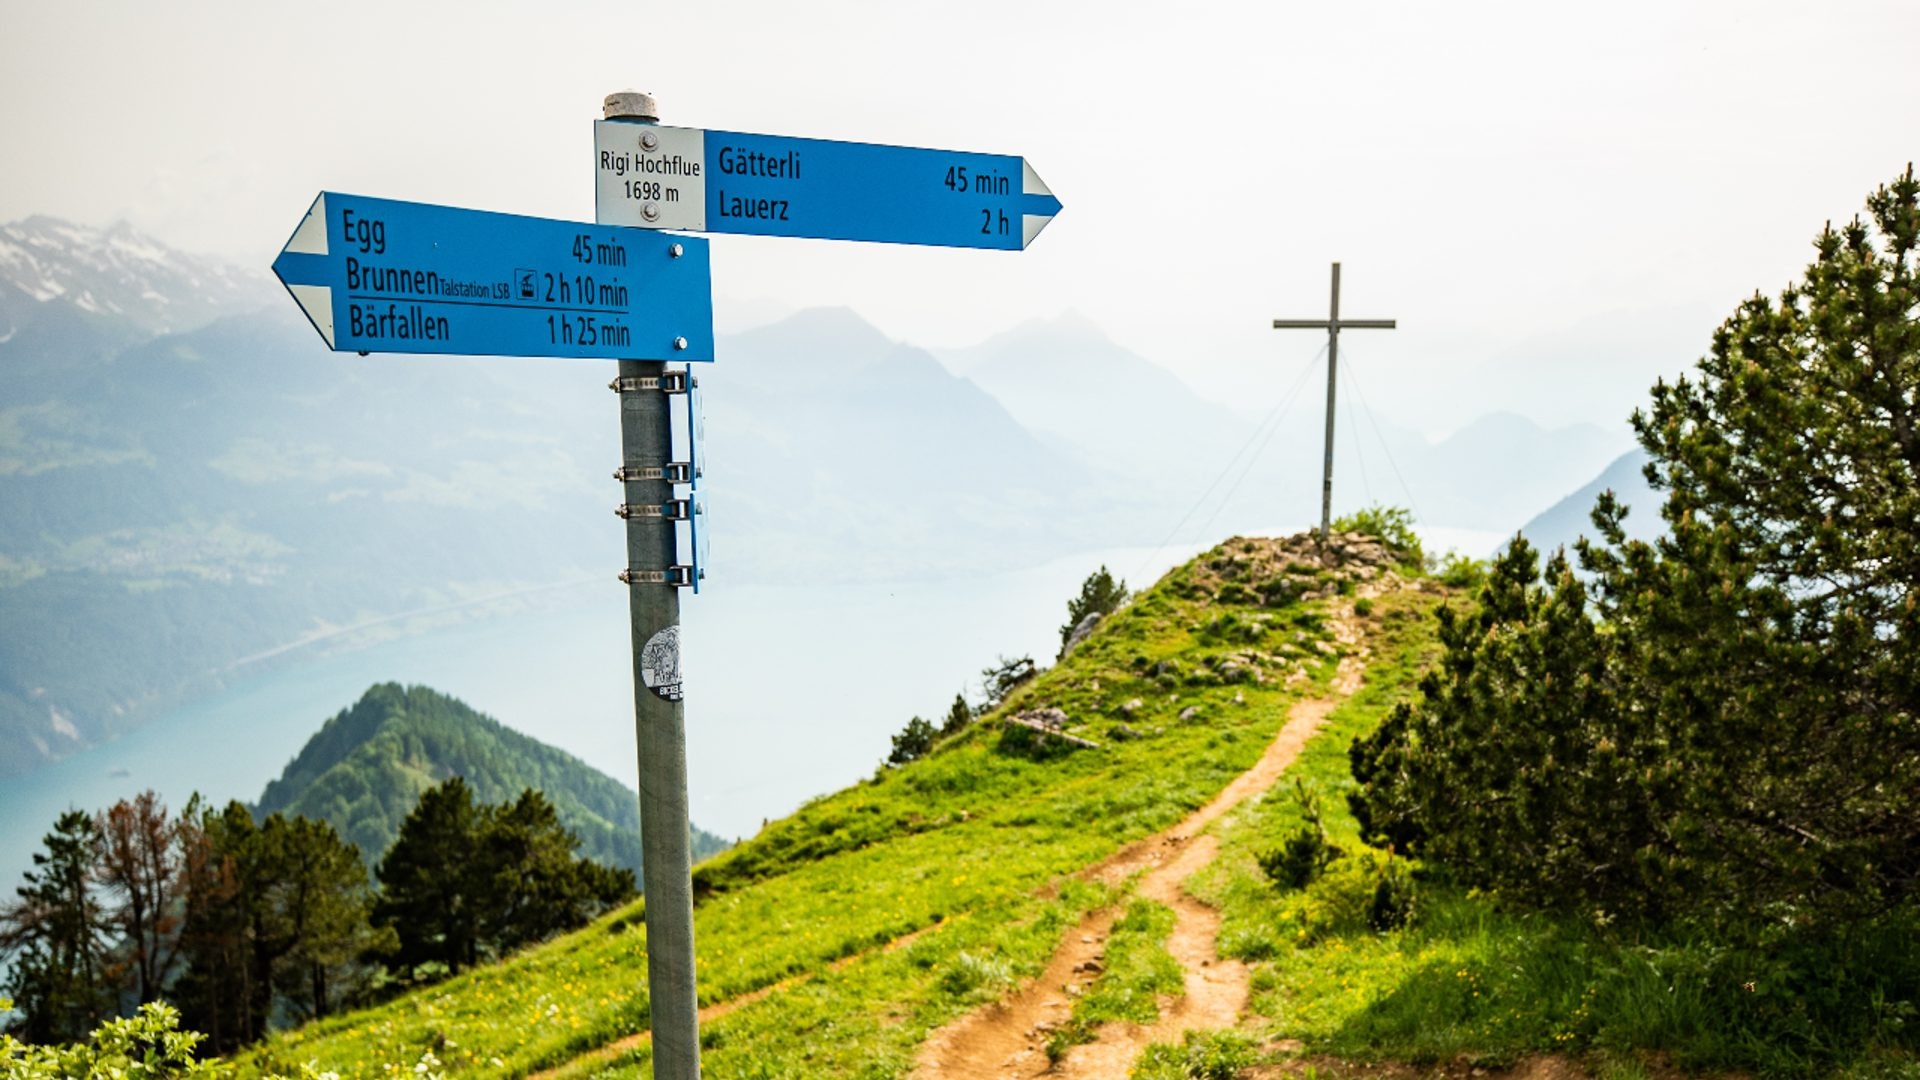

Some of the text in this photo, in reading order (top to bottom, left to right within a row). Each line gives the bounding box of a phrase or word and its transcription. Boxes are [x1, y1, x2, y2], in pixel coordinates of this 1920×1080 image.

[601, 151, 699, 176] Rigi Hochflue
[719, 147, 800, 178] Gätterli
[625, 181, 678, 202] 1698 m
[945, 166, 1008, 195] 45 min
[720, 190, 788, 220] Lauerz
[343, 209, 385, 254] Egg
[981, 209, 1008, 235] 2 h
[573, 235, 626, 266] 45 min
[348, 258, 510, 299] Brunnen Talstation LSB
[545, 273, 627, 306] 2 h 10 min
[350, 304, 448, 340] Bärfallen
[548, 315, 630, 346] 1 h 25 min
